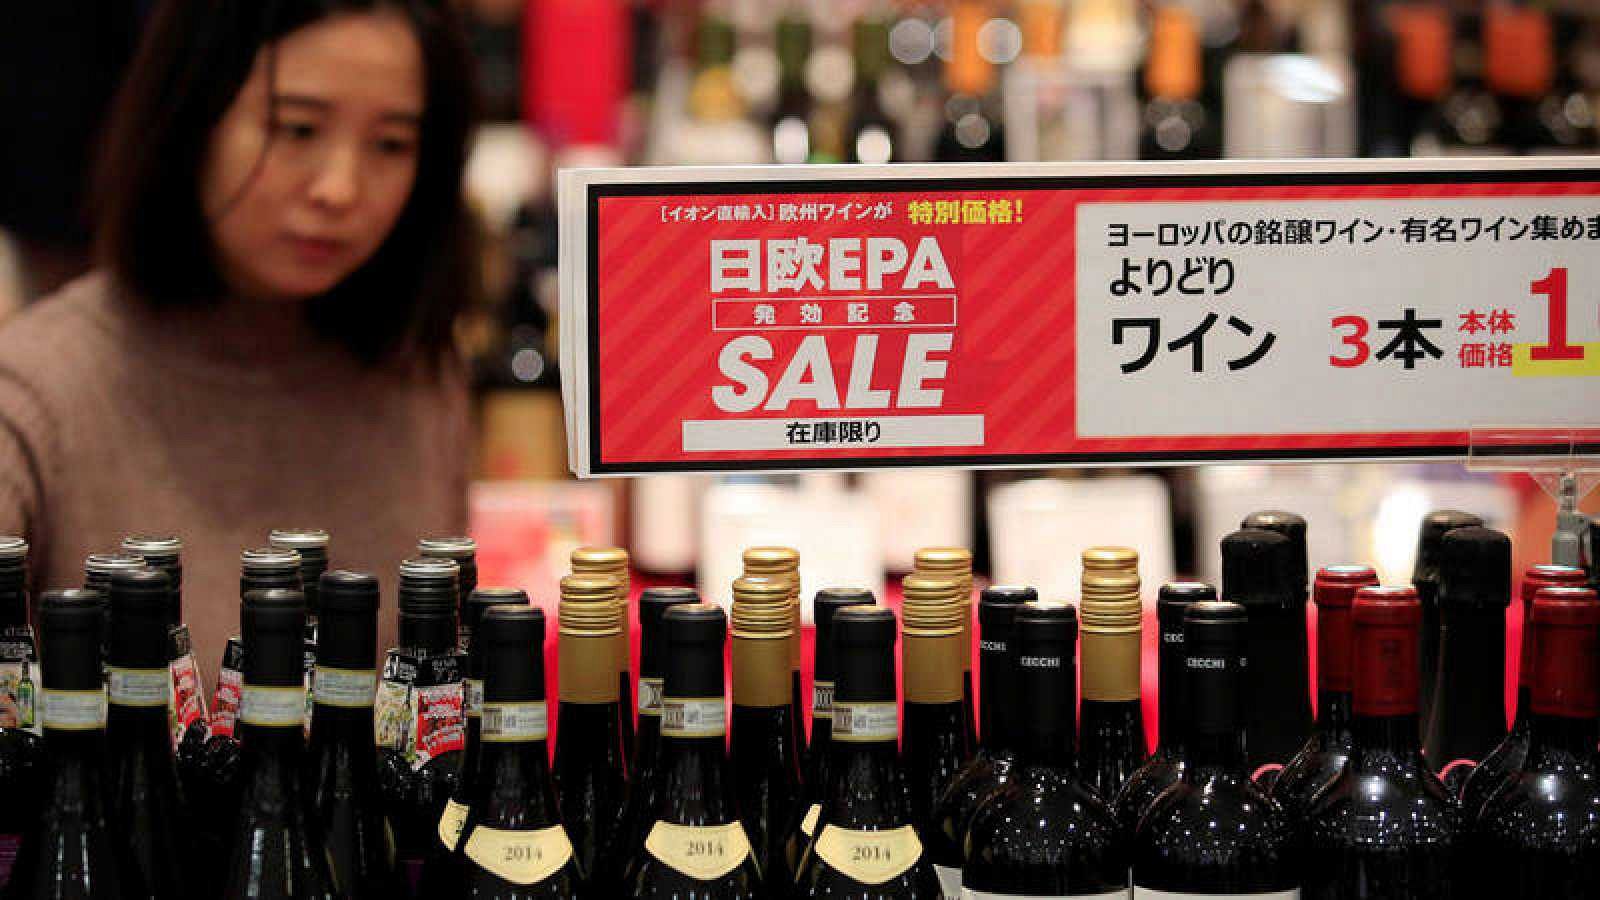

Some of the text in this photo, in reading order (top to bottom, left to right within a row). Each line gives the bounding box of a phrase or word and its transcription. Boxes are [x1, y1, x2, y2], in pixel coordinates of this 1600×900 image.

[908, 198, 1024, 225] 特別価格!
[710, 236, 956, 294] 日欧EPA
[1109, 256, 1236, 297] よりどり
[753, 302, 917, 325] 発効記念
[1458, 309, 1516, 336] 本体
[1530, 267, 1588, 361] 1
[1111, 308, 1444, 374] ワイン 3本
[1458, 342, 1514, 369] 価格
[711, 333, 955, 413] SALE
[785, 421, 882, 445] 在庫限り
[502, 845, 543, 863] 2014
[685, 839, 725, 857] 2014
[851, 845, 892, 863] 2014
